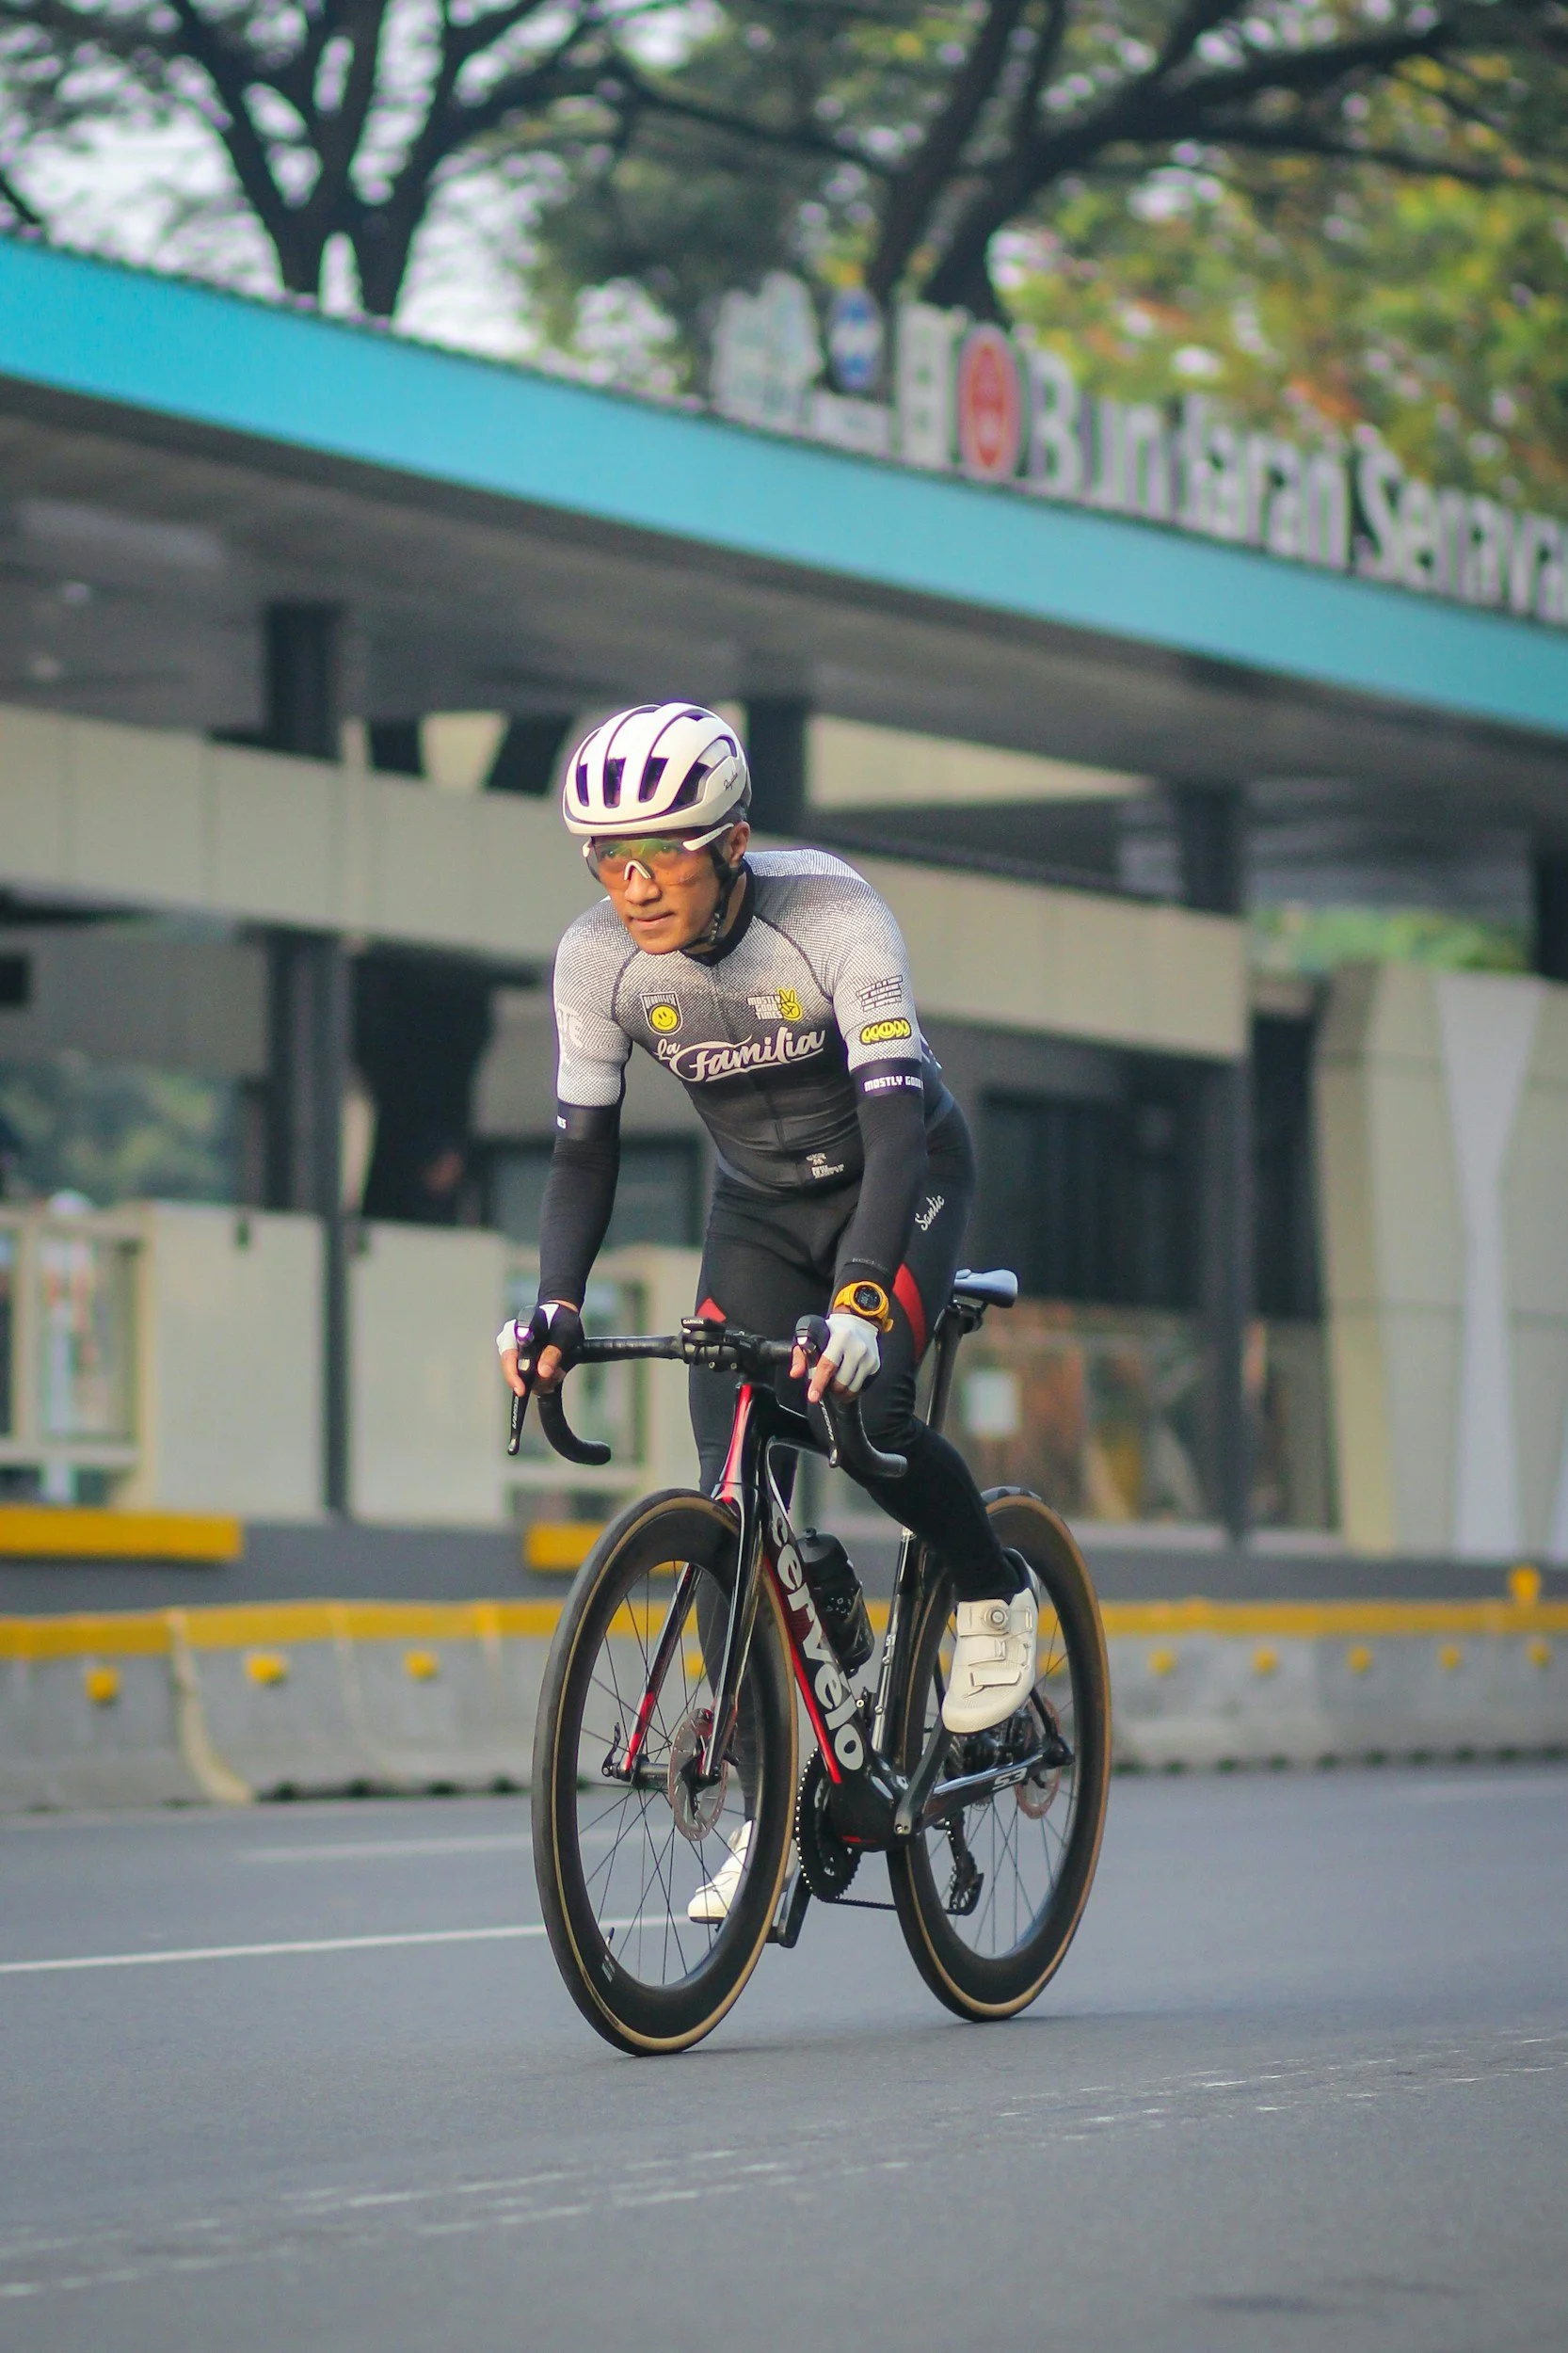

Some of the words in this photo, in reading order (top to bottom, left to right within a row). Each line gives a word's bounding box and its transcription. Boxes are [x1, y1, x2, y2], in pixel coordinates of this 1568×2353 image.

[746, 995, 781, 1006] MOSTLY
[754, 1003, 780, 1013] GOOD
[755, 1010, 784, 1020] TIMES
[669, 1026, 826, 1082] Familia
[863, 1075, 904, 1093] MOSTLY
[992, 1766, 1028, 1791] S3
